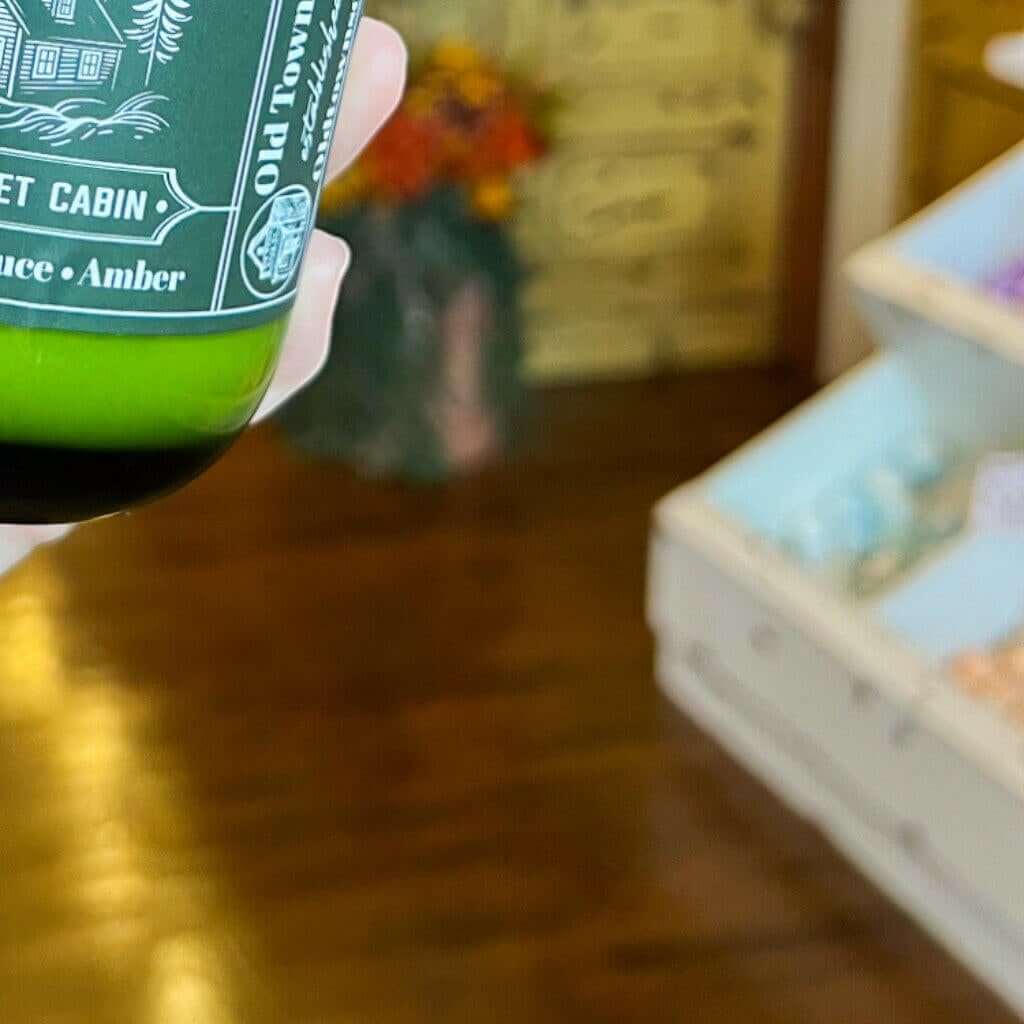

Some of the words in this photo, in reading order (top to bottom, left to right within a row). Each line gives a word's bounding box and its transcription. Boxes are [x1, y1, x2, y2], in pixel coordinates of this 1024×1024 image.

[254, 122, 289, 196] Old
[49, 181, 148, 222] CABIN
[76, 257, 187, 292] Amber
